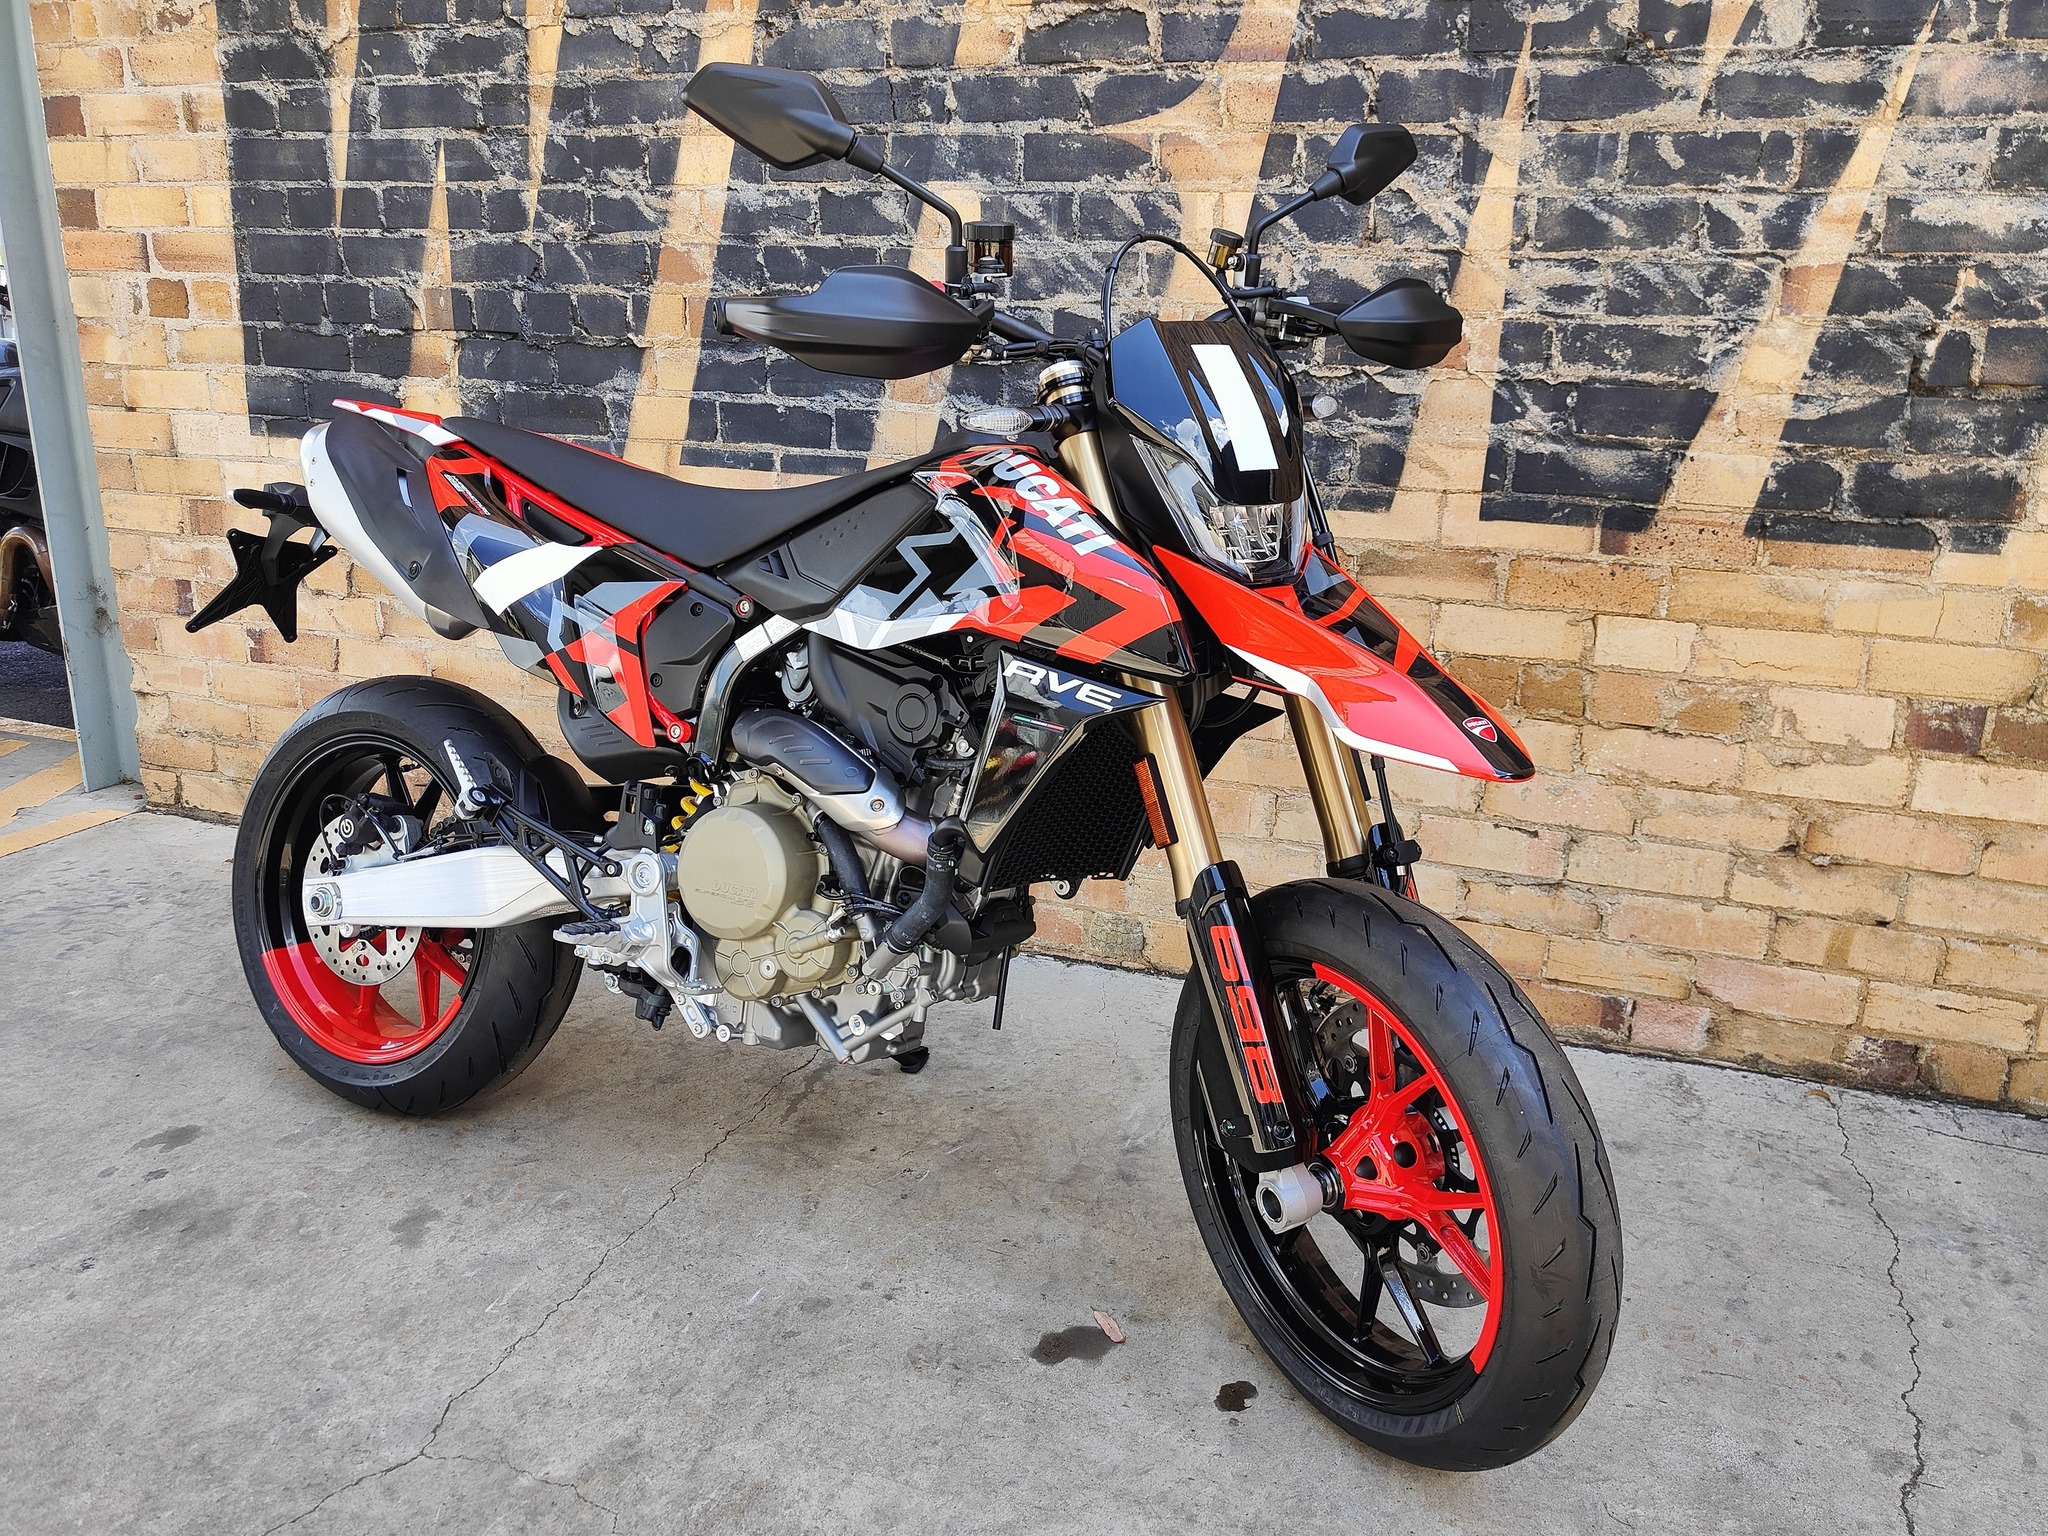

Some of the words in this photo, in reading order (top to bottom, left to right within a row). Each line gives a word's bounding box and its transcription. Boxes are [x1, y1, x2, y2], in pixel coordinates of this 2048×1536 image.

[970, 448, 1117, 557] DUCATI
[1003, 660, 1123, 714] RVE
[1466, 720, 1488, 728] DUCATI
[712, 879, 759, 900] DUCATI
[1210, 925, 1284, 1104] 698
